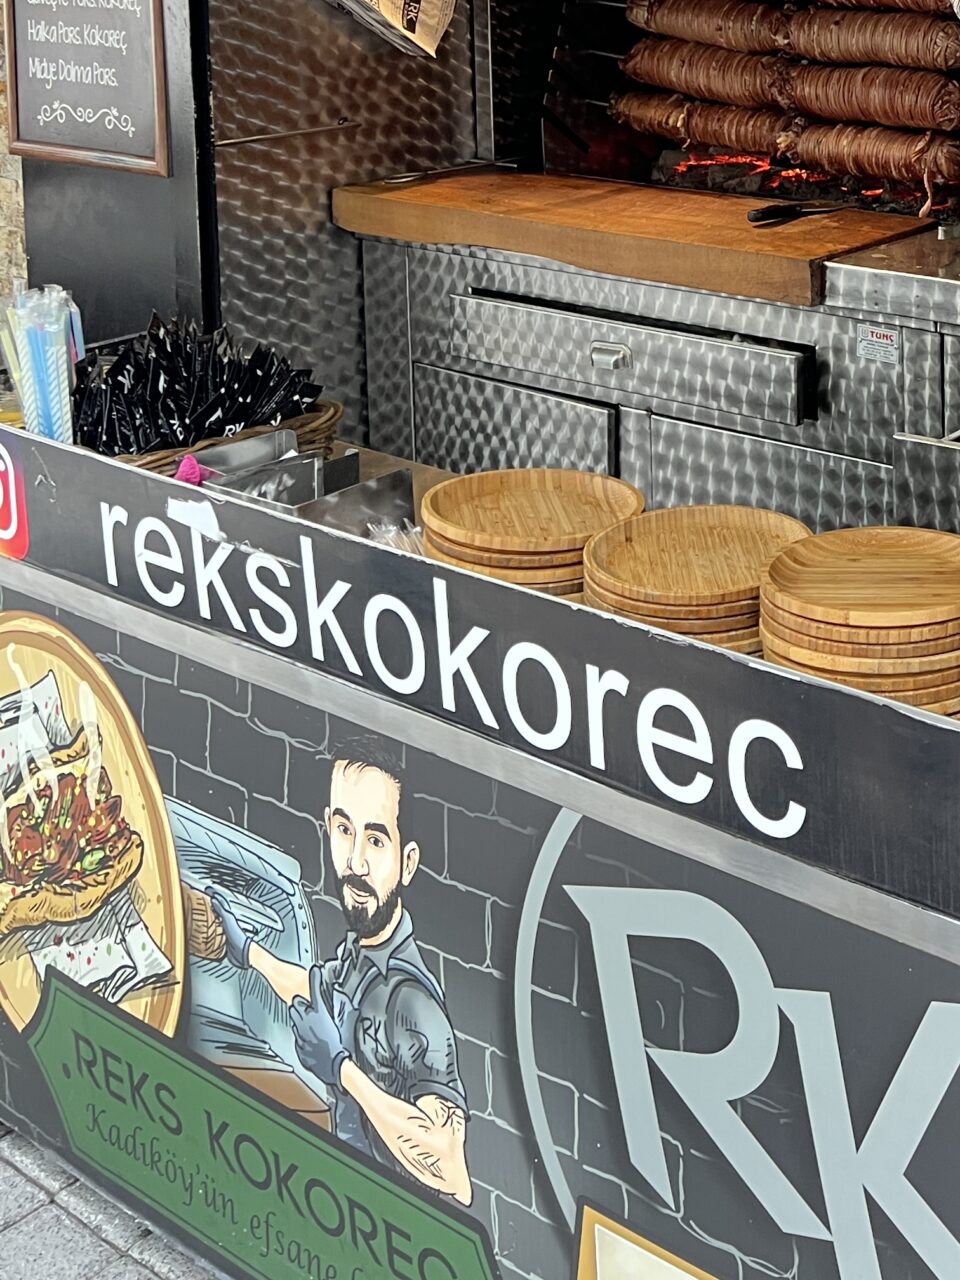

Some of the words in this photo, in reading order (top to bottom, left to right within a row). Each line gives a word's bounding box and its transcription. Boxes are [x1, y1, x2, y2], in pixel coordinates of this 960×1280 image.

[406, 2, 420, 22] RK
[98, 499, 808, 840] rekskokorec
[360, 1015, 388, 1053] RK
[71, 1028, 184, 1137] REKS
[249, 1210, 338, 1280] efsane
